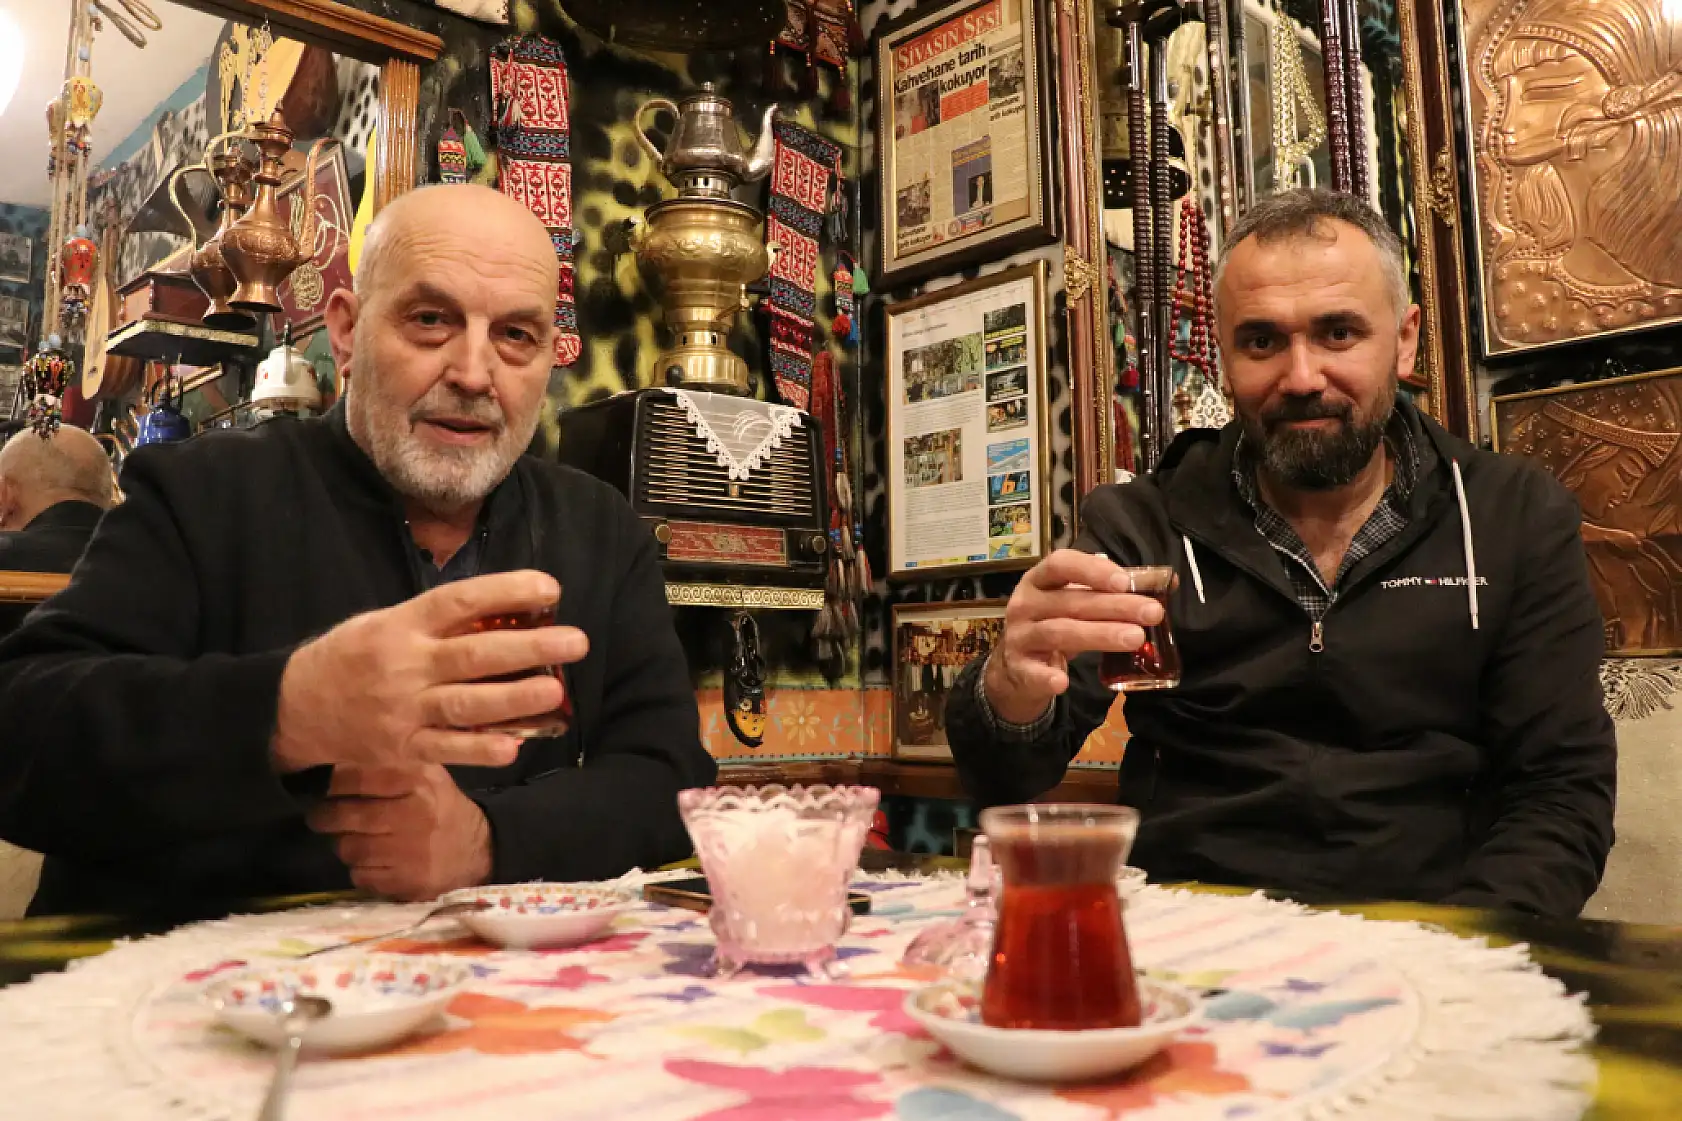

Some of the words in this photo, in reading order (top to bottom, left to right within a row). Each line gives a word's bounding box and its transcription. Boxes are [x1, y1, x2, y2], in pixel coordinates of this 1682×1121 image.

[893, 58, 956, 94] Kahvehane
[958, 43, 985, 66] tarih
[939, 64, 987, 93] kokuyor
[1381, 577, 1422, 589] TOMMY
[1438, 576, 1490, 586] HILFIER
